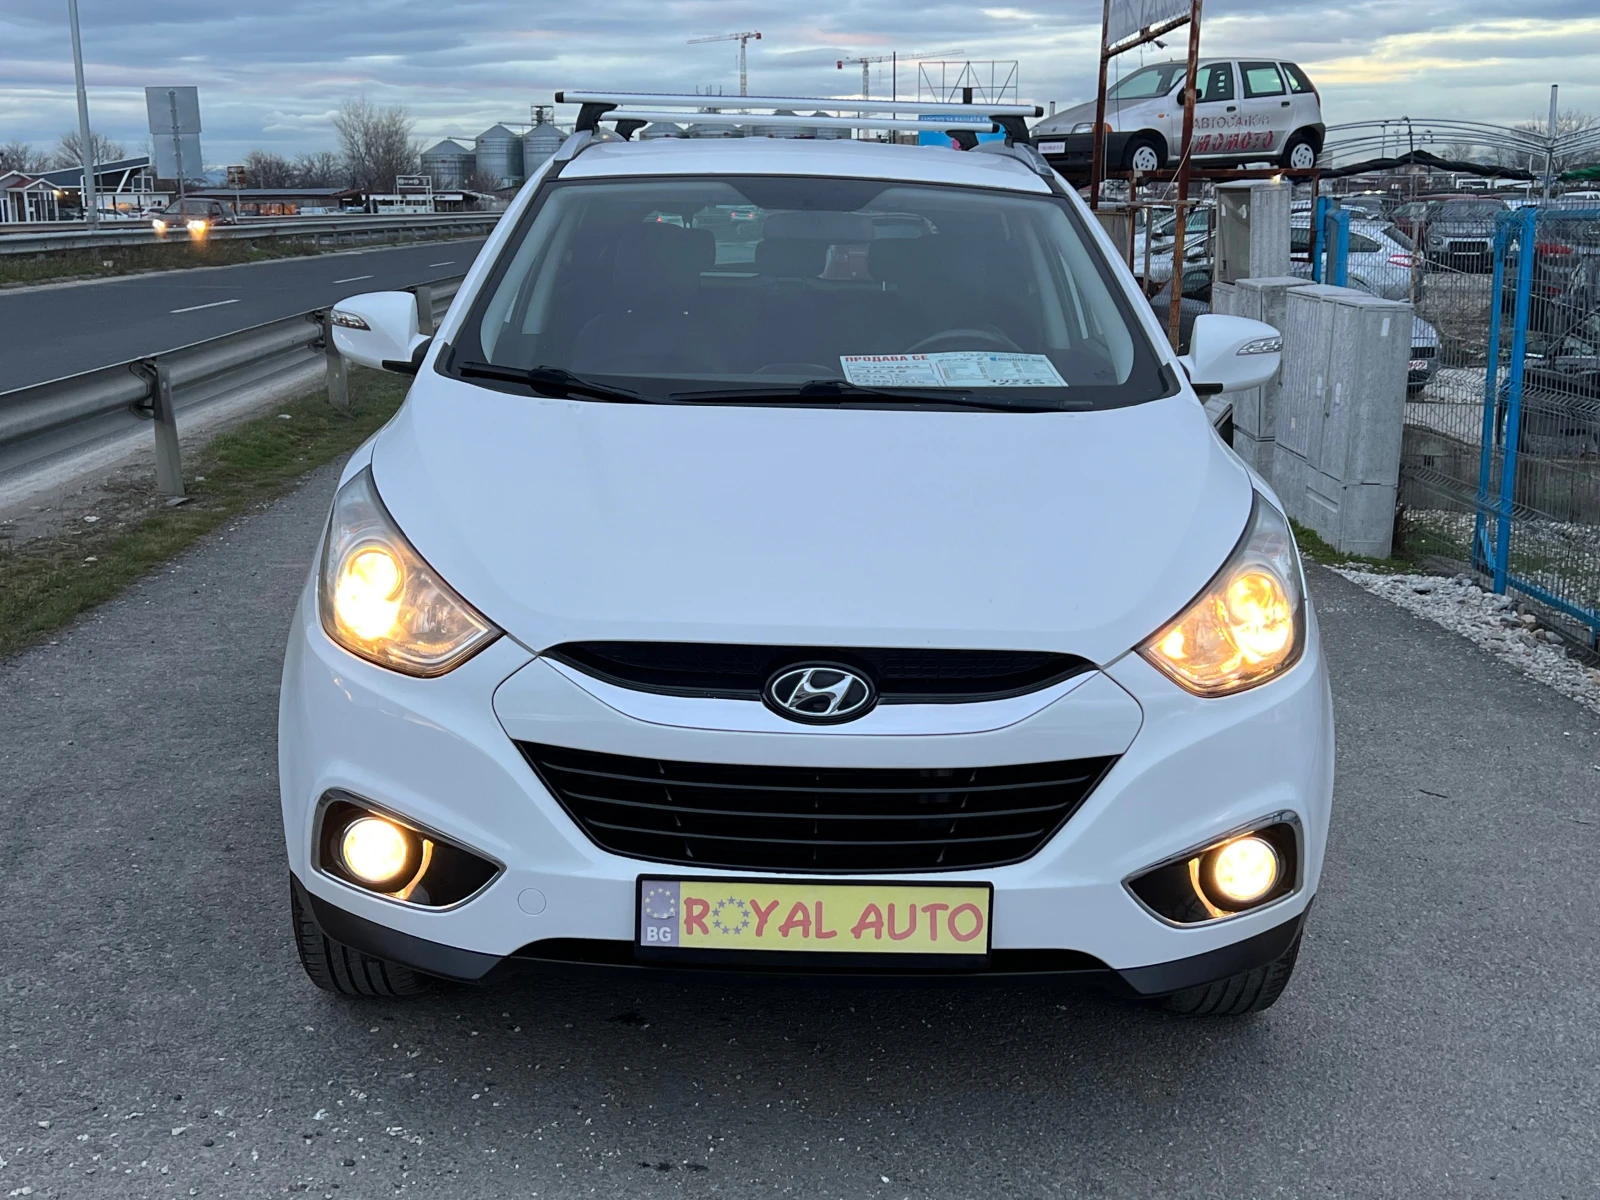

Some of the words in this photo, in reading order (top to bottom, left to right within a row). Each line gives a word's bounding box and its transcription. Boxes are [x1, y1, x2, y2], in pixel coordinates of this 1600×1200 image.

[844, 355, 908, 363] ПРОДАВА
[850, 902, 984, 942] AUTO
[646, 926, 671, 943] BG
